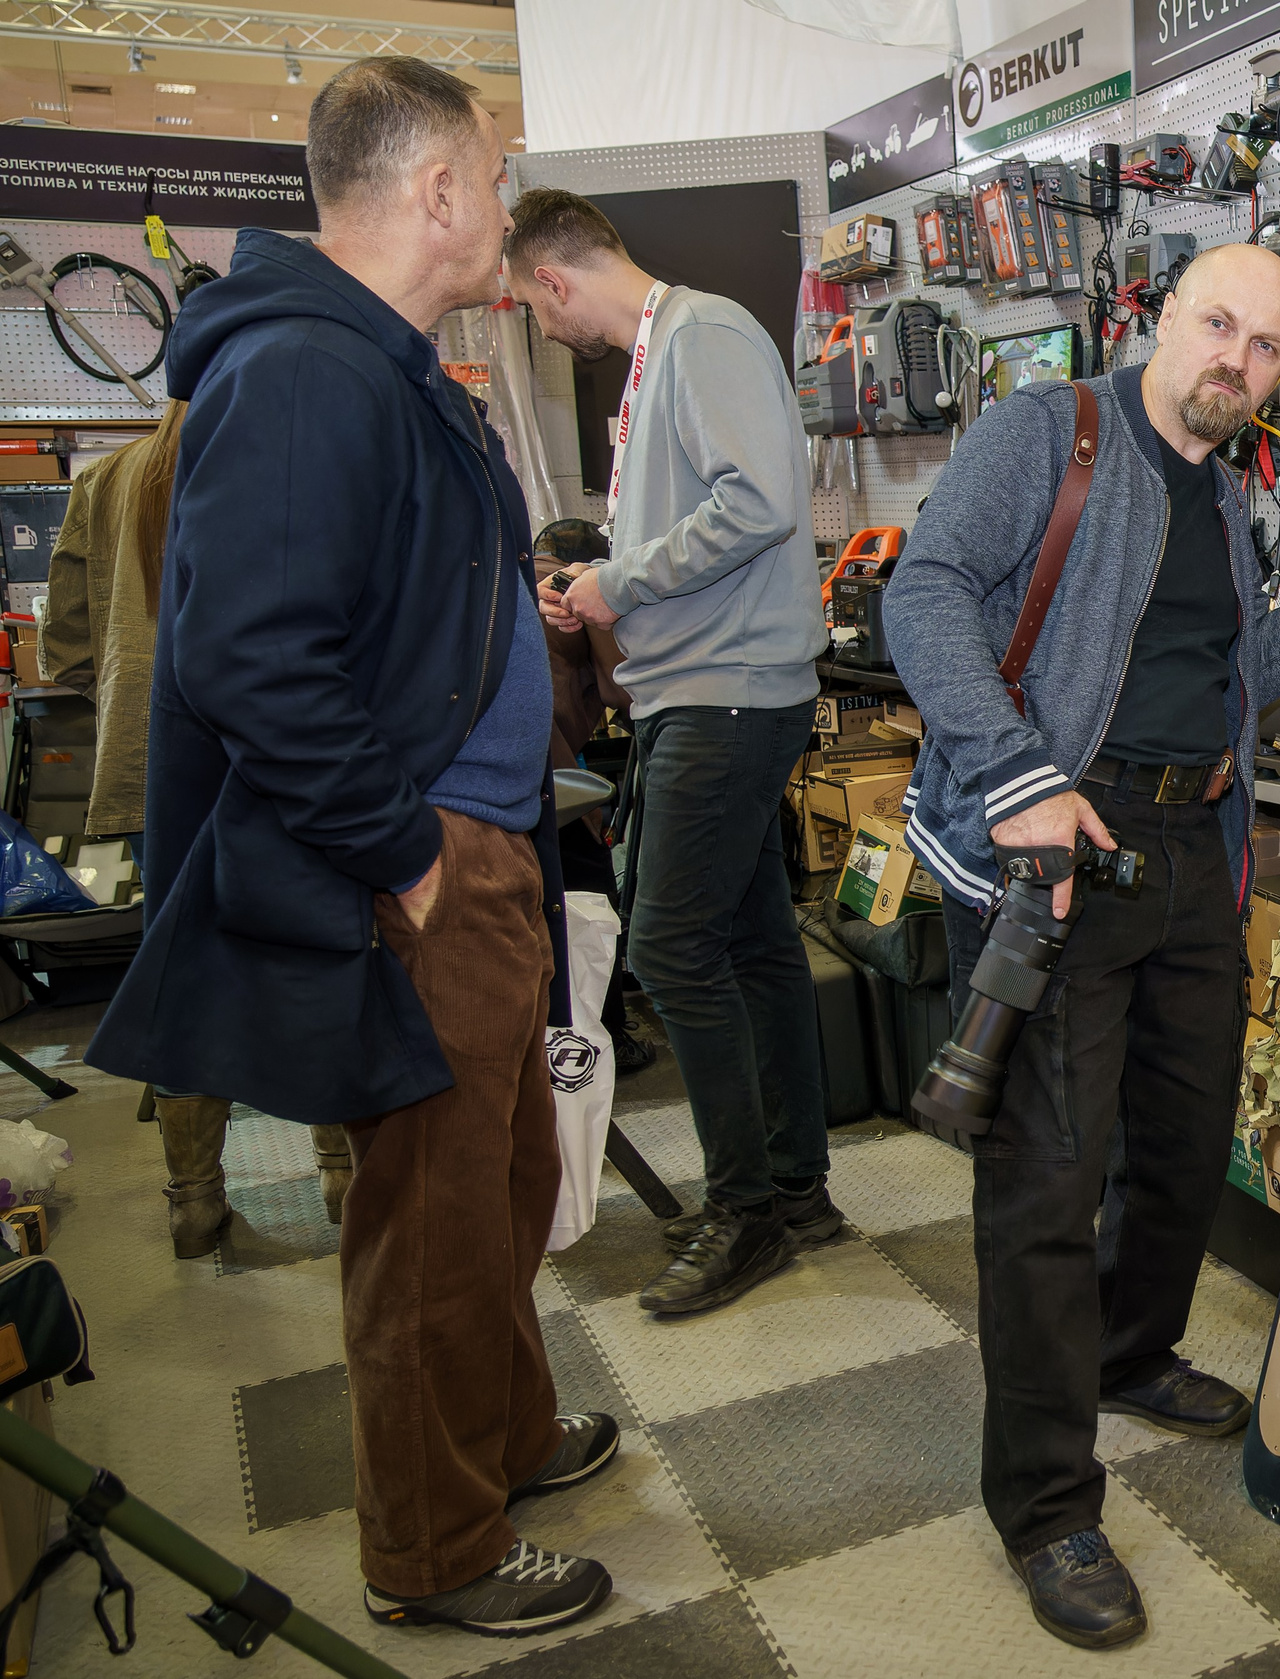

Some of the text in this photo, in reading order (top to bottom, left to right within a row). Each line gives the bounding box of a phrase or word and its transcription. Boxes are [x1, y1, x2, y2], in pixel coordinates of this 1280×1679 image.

[989, 27, 1084, 103] BERKUT
[1006, 83, 1121, 141] BERKUT PROFESSIONAL
[0, 158, 303, 187] ЭЛЕКТРИЧЕСКИЕ НАСОСЫ ДЛЯ ПЕРЕКАЧКИ
[0, 174, 77, 190] ТОПЛИВА
[82, 179, 93, 190] И
[213, 186, 306, 202] ЖИДКОСТЕЙ
